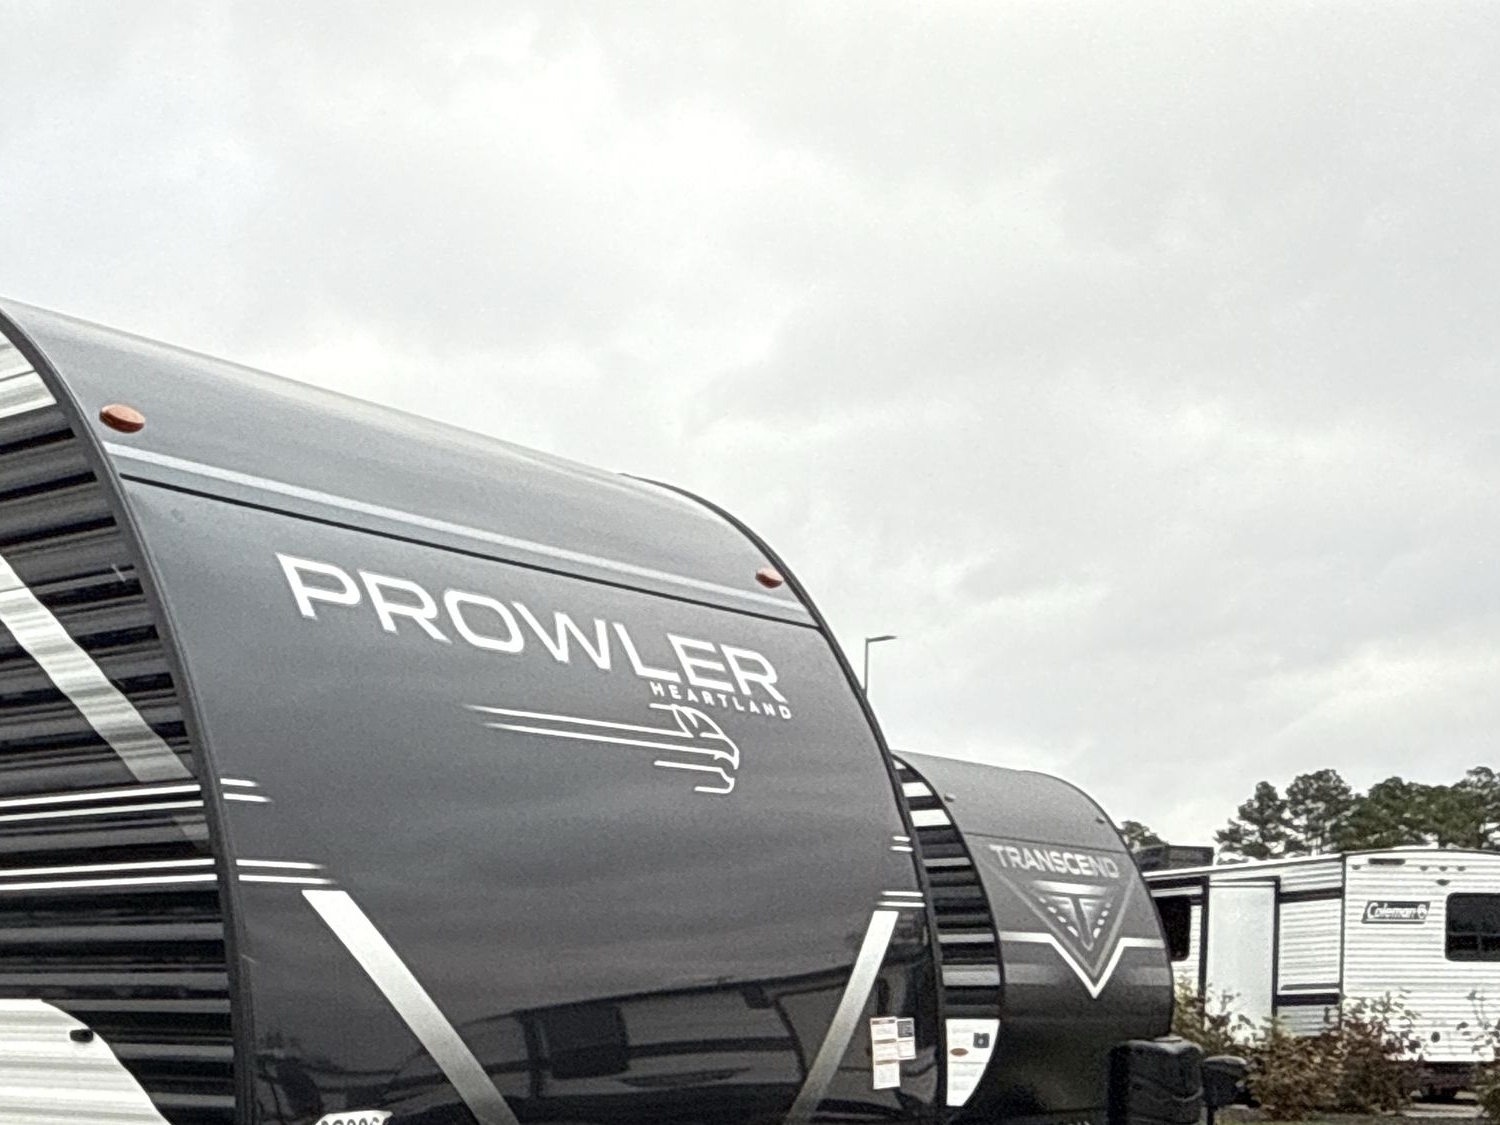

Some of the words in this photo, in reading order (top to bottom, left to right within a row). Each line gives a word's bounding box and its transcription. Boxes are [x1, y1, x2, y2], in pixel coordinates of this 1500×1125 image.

[275, 552, 789, 702] PROWLER
[649, 680, 792, 720] HEARTLAND
[989, 843, 1120, 879] TRANSCEND
[1366, 901, 1417, 919] Coleman
